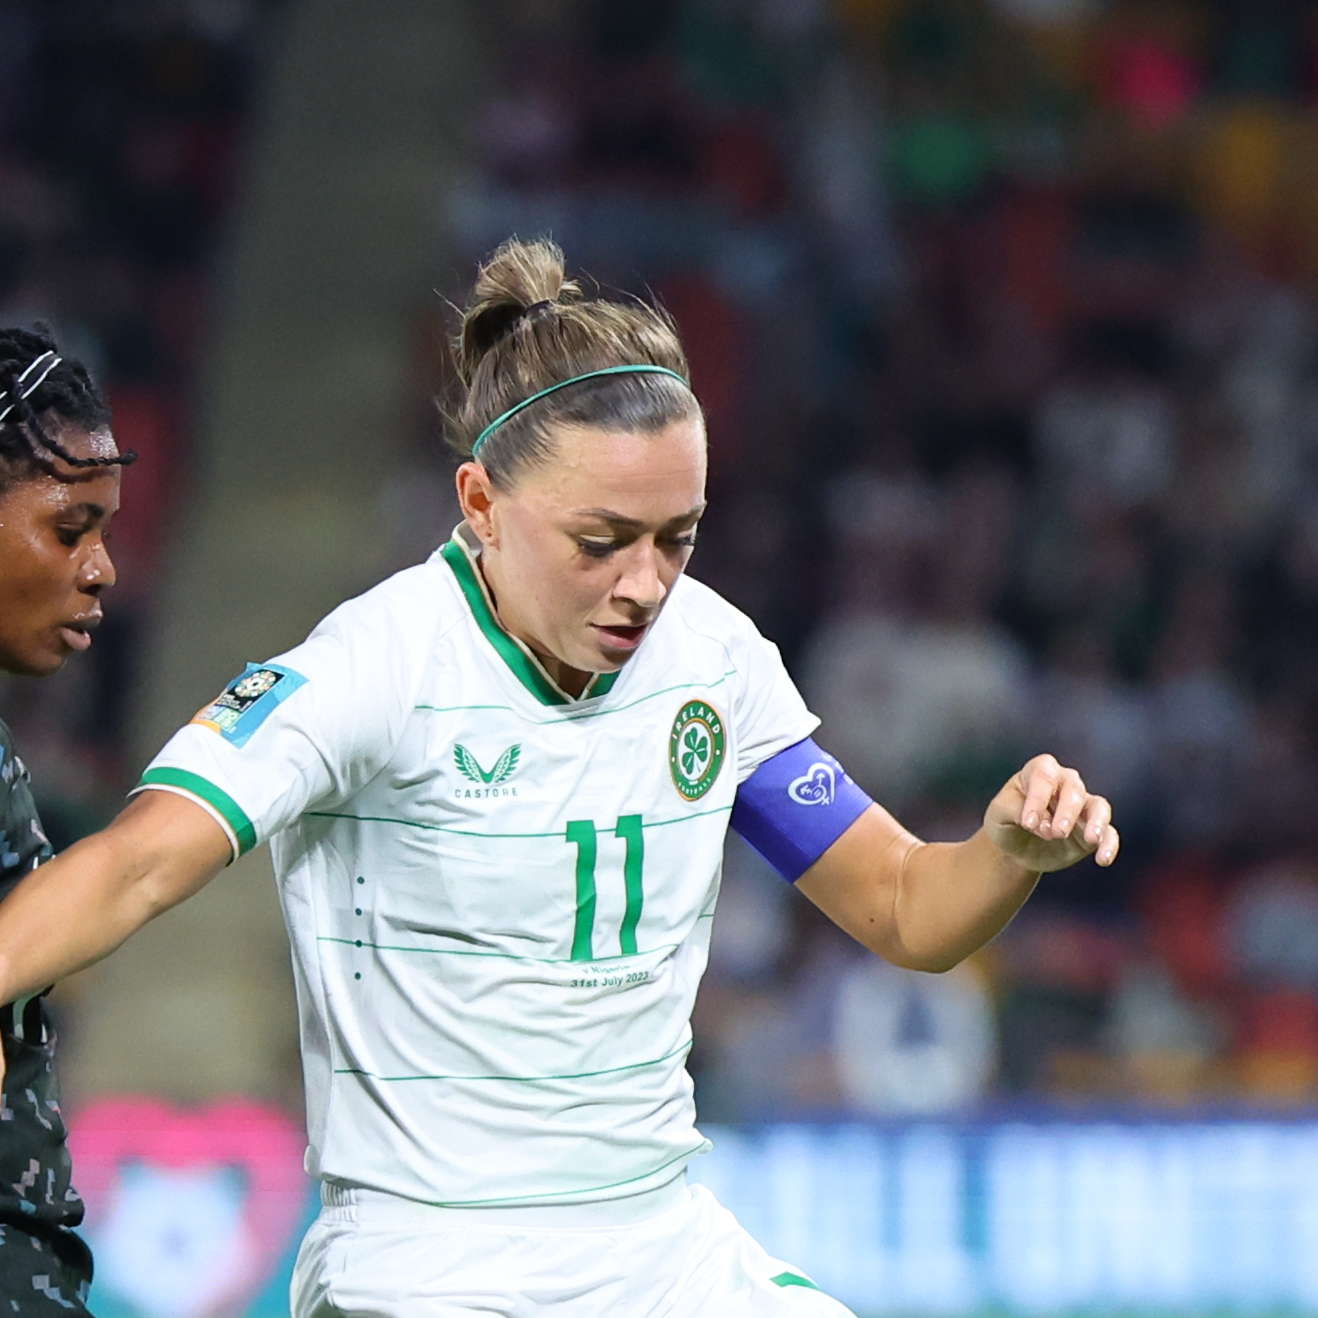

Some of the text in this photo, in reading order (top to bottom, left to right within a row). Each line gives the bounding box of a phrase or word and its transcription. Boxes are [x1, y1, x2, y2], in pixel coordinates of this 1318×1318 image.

[671, 706, 721, 740] IRELAND
[454, 787, 518, 799] CASTORE
[565, 814, 645, 962] 11
[570, 970, 650, 988] 31st July 2023
